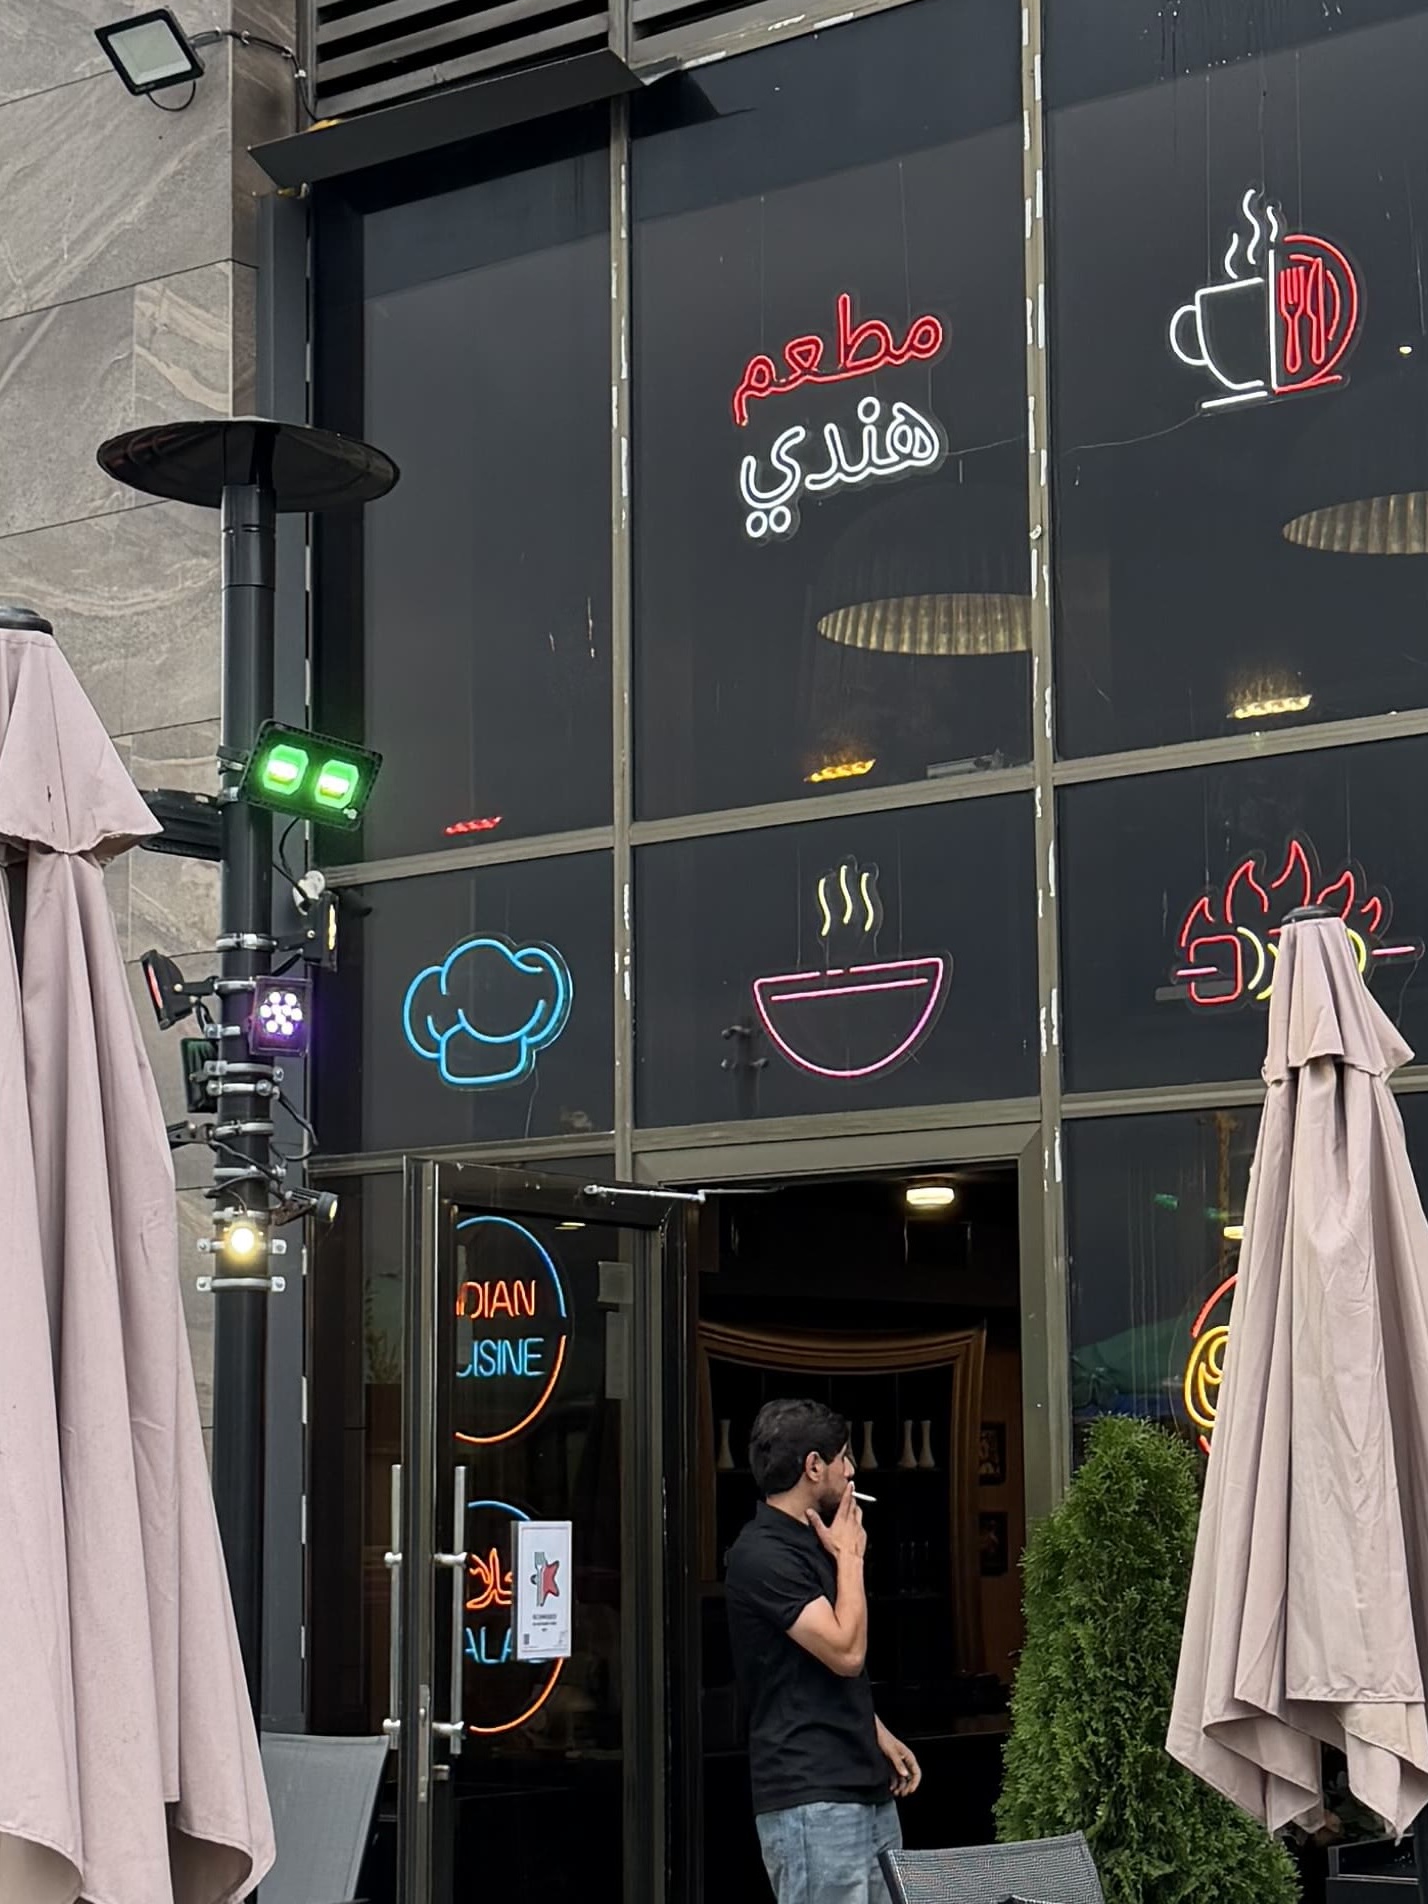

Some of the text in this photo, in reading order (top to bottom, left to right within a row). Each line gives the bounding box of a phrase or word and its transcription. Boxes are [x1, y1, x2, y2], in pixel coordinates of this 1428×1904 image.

[732, 291, 944, 427] مطعم
[738, 394, 941, 539] هندي
[455, 1279, 537, 1319] DIAN
[455, 1337, 546, 1378] ISINE
